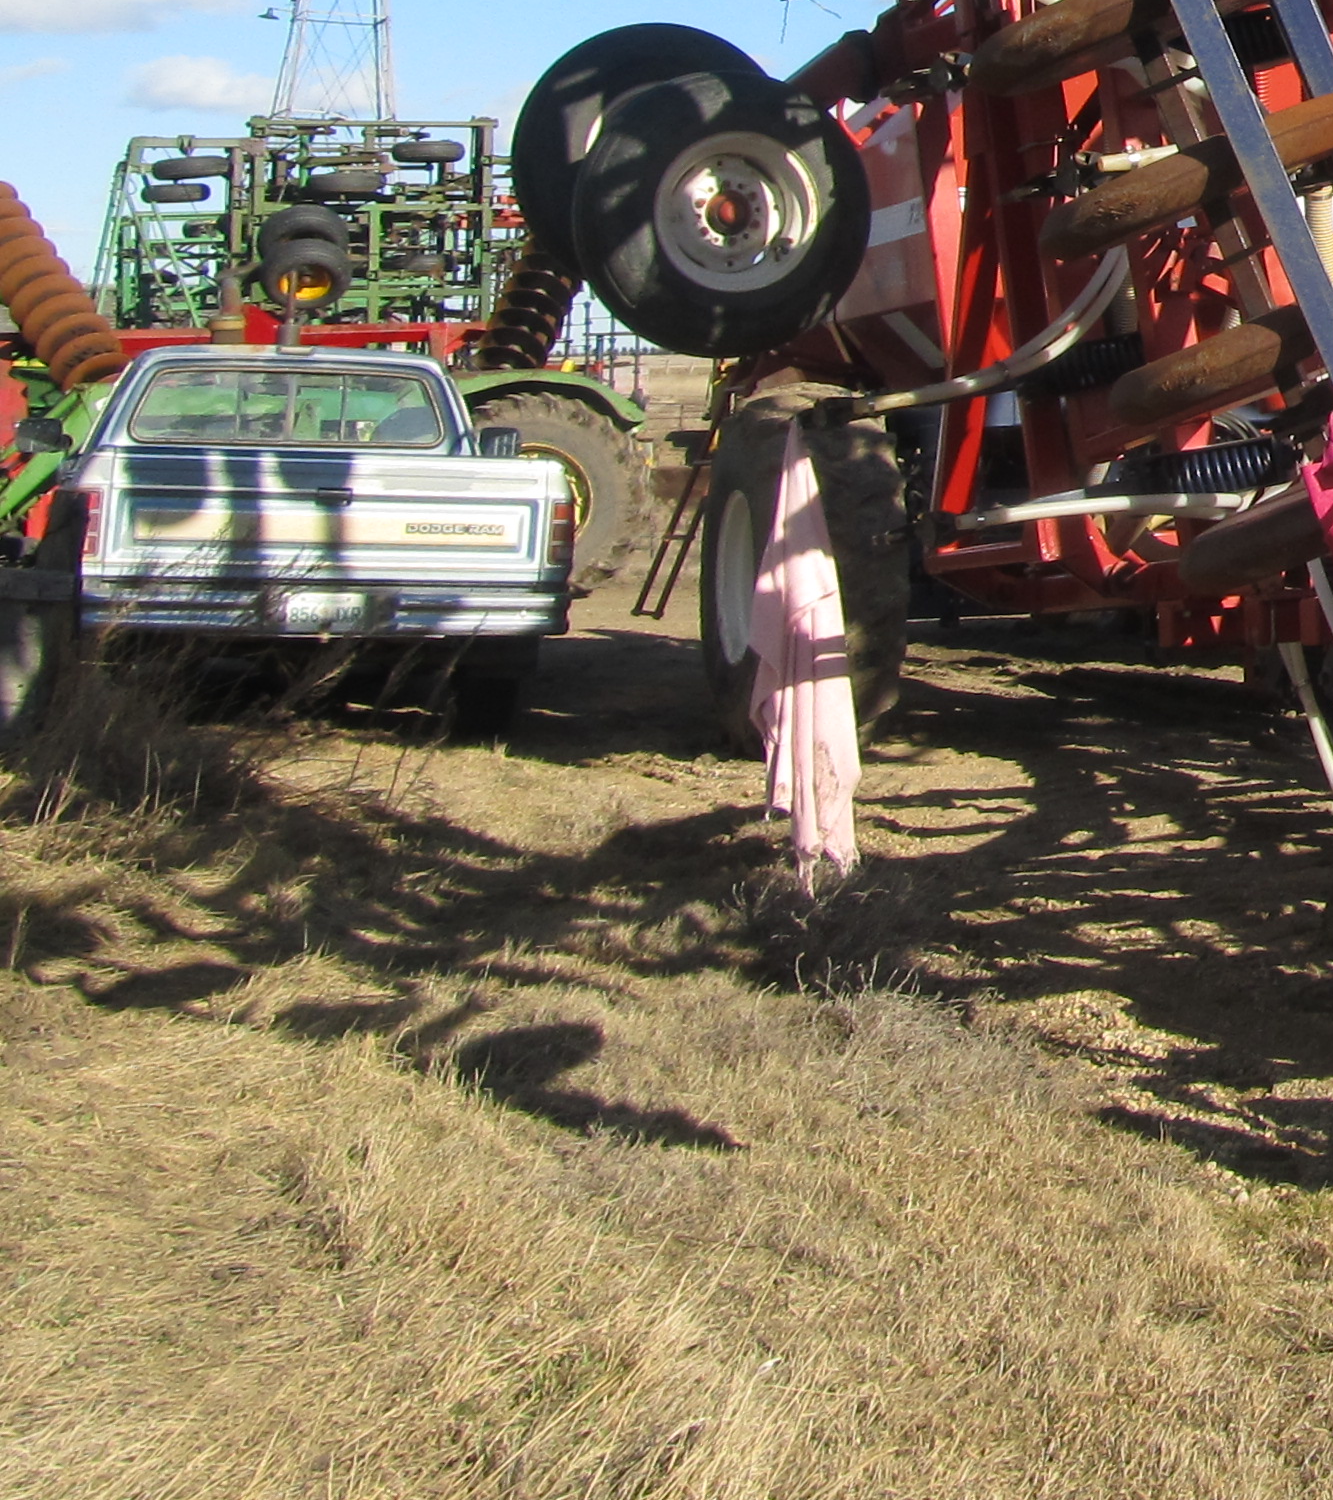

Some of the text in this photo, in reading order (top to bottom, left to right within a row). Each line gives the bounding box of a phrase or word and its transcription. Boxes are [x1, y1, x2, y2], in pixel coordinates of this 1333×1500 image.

[406, 523, 505, 535] DODGE RAM
[289, 606, 319, 623] 856
